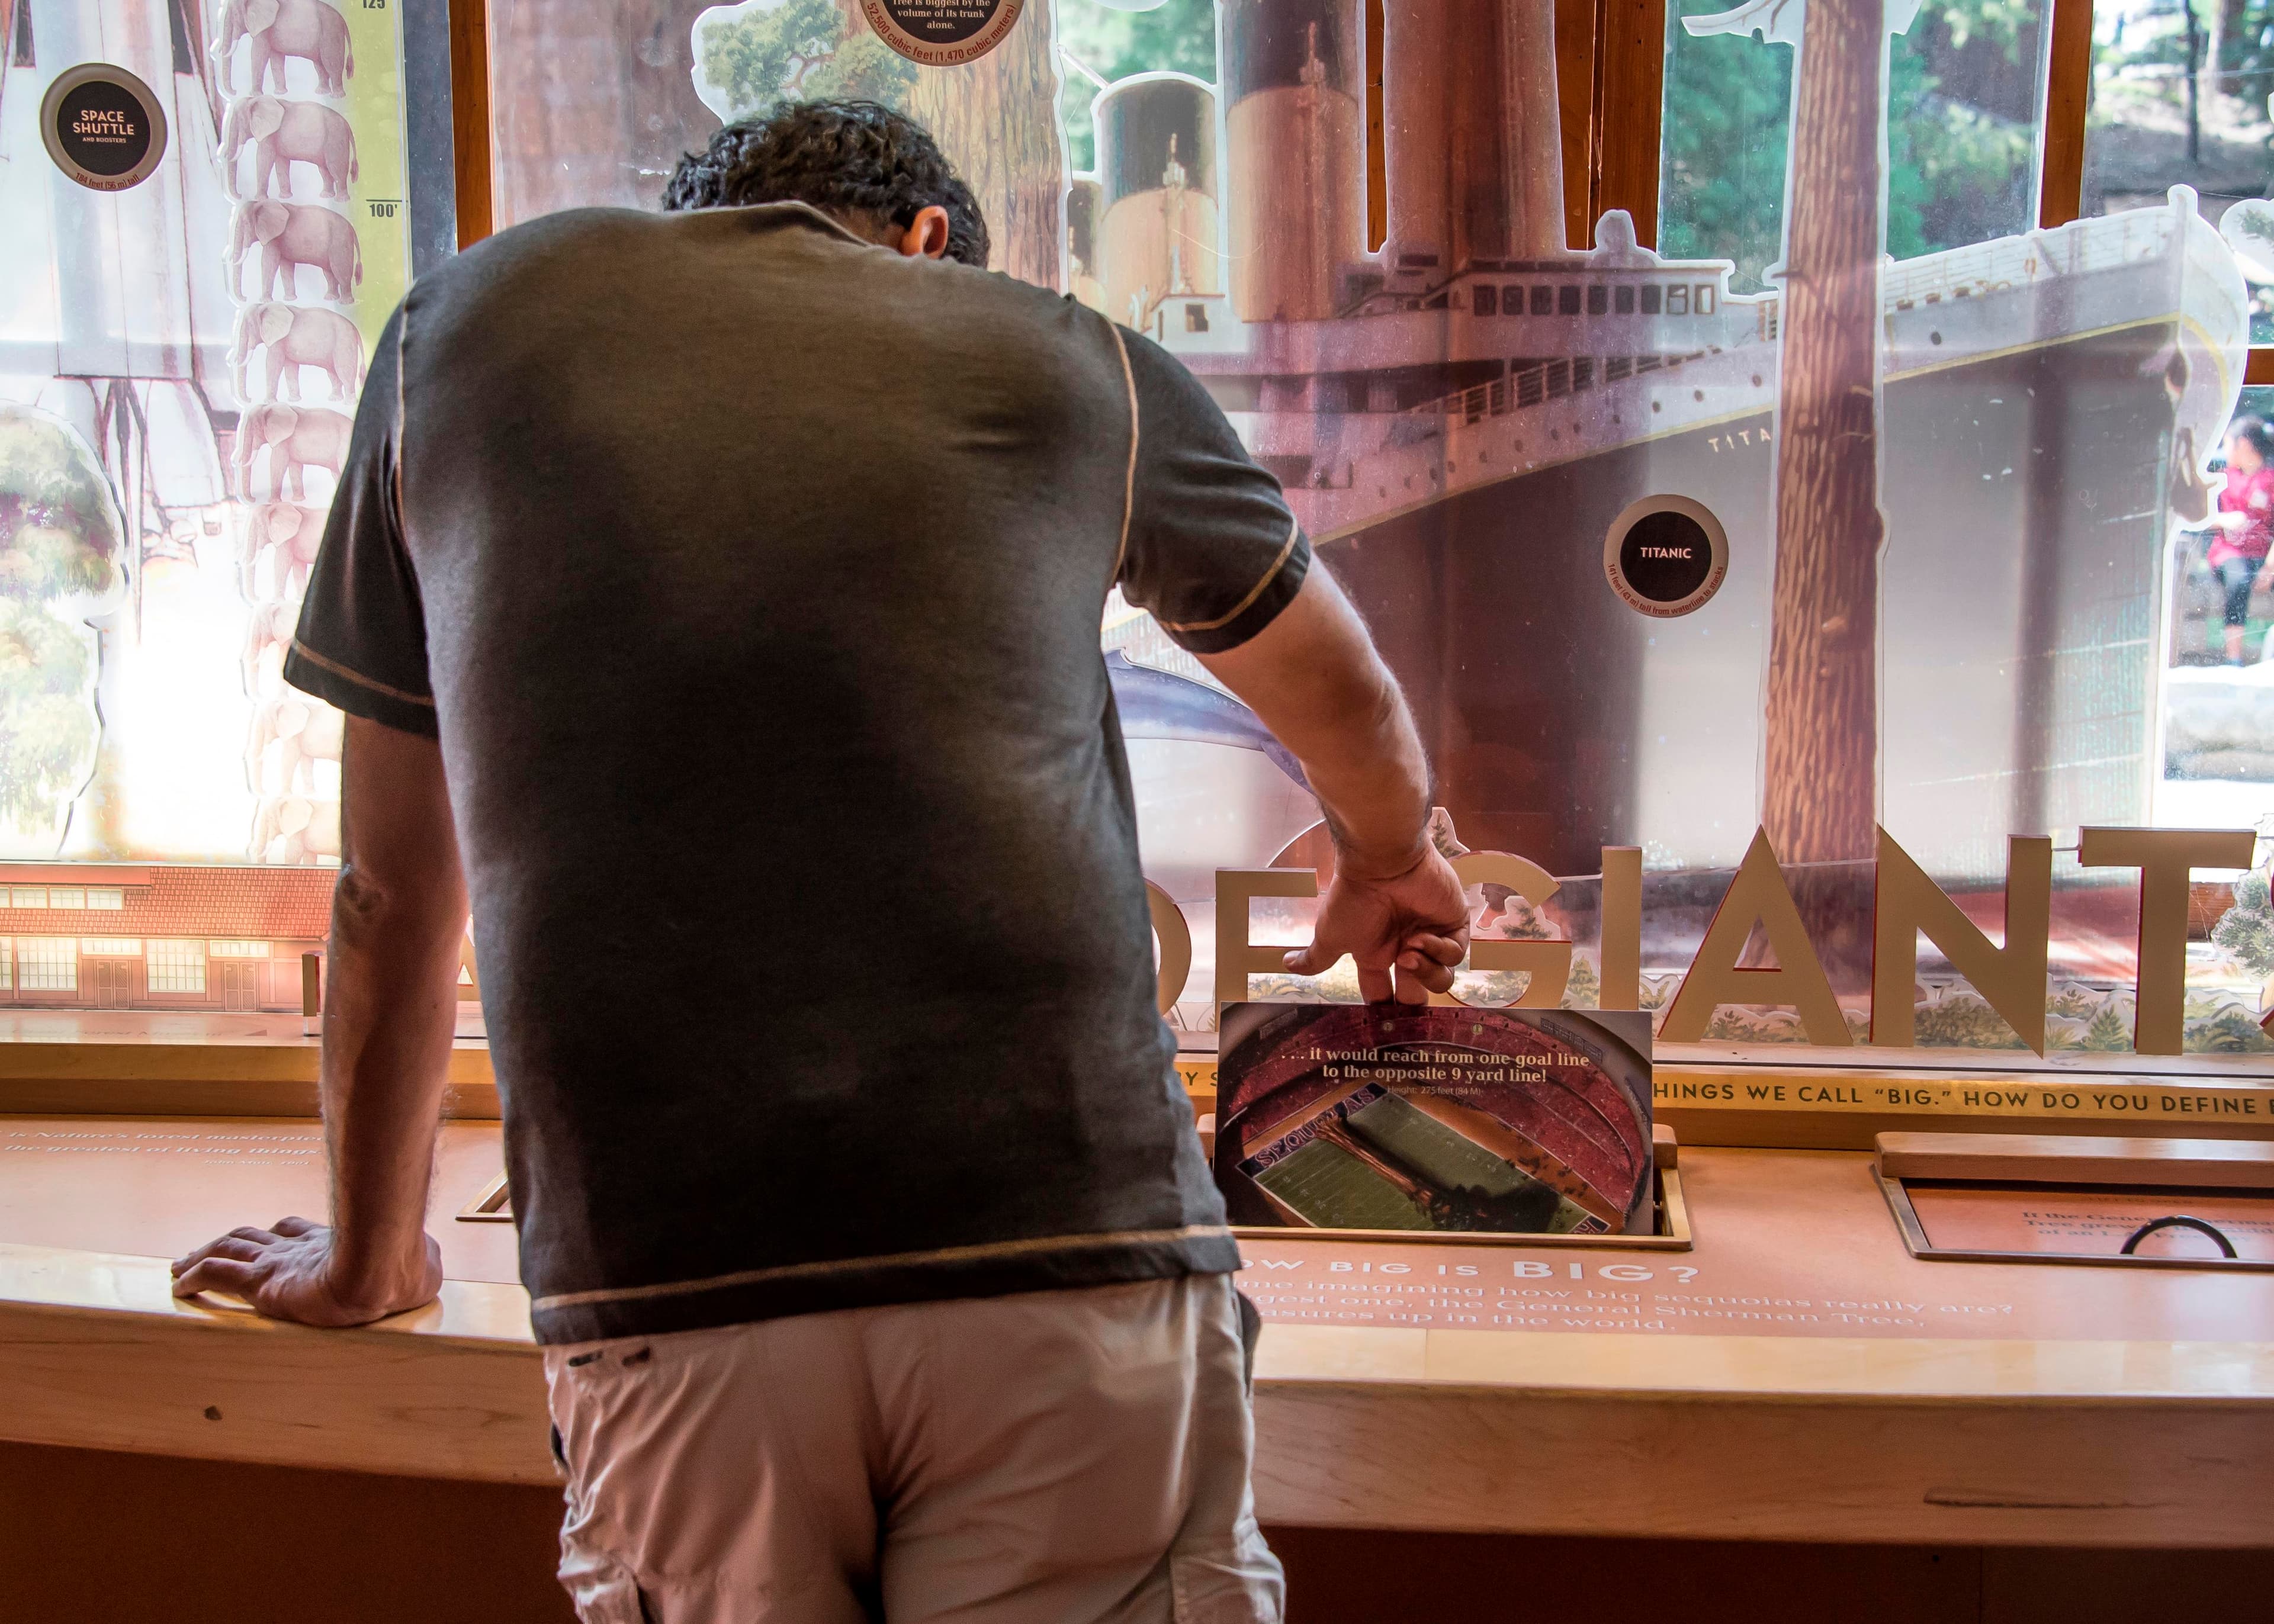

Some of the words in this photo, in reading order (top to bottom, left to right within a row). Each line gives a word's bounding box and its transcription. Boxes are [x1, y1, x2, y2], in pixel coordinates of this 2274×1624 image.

[898, 9, 932, 17] volume
[946, 9, 958, 18] its
[867, 2, 890, 34] 52,500
[888, 33, 911, 53] cubic
[913, 46, 933, 60] feet
[935, 48, 964, 63] (1,470
[966, 37, 992, 56] cubic
[991, 4, 1017, 40] meters)
[926, 21, 955, 29] alone.
[81, 110, 124, 123] SPACE
[72, 122, 135, 136] SHUTTLE
[75, 172, 88, 184] 184
[89, 178, 103, 188] feet
[127, 173, 140, 185] tall
[369, 204, 397, 217] 100'
[1707, 427, 1771, 453] TITA
[1640, 547, 1692, 559] TITANIC
[1608, 563, 1617, 575] 141
[1709, 566, 1724, 590] stacks
[1611, 576, 1624, 591] feet
[1639, 603, 1652, 613] tall
[1671, 595, 1705, 615] waterline
[1428, 822, 2274, 1060] GIANT
[1309, 1047, 1321, 1060] it
[1326, 1048, 1379, 1062] would
[1383, 1049, 1429, 1063] reach
[1434, 1050, 1474, 1064] from
[1479, 1054, 1510, 1065] one
[1515, 1053, 1552, 1068] goal
[1558, 1053, 1589, 1066] line
[1323, 1065, 1338, 1077] to
[1344, 1065, 1370, 1078] the
[1374, 1066, 1446, 1082] opposite
[1451, 1067, 1462, 1080] 9
[1466, 1069, 1504, 1084] yard
[1509, 1068, 1547, 1082] line!
[1653, 1083, 1735, 1099] HINGS
[1746, 1085, 1786, 1101] WE
[1798, 1086, 1863, 1103] CALL
[1963, 1091, 2029, 1108] HOW
[2042, 1092, 2080, 1110] DO
[2092, 1094, 2148, 1111] YOU
[2160, 1096, 2256, 1114] DEFINE
[175, 1147, 242, 1155] living
[1329, 1260, 1412, 1274] BIG
[1438, 1264, 1479, 1276] IS
[1513, 1260, 1699, 1284] BIG?
[1306, 1281, 1485, 1297] imagining
[1498, 1287, 1573, 1298] how
[1586, 1289, 1640, 1303] big
[1654, 1294, 1812, 1308] sequoias
[1825, 1300, 1924, 1314] really
[1939, 1304, 2013, 1314] are?
[1260, 1309, 1375, 1320] asures
[1388, 1313, 1433, 1323] up
[1447, 1312, 1479, 1323] in
[1492, 1314, 1550, 1325] the
[1560, 1317, 1676, 1330] world.
[1340, 1297, 1413, 1308] one,
[1428, 1298, 1484, 1309] the
[1496, 1300, 1640, 1314] General
[1655, 1305, 1819, 1322] Sherman
[1830, 1312, 1925, 1327] Tree,
